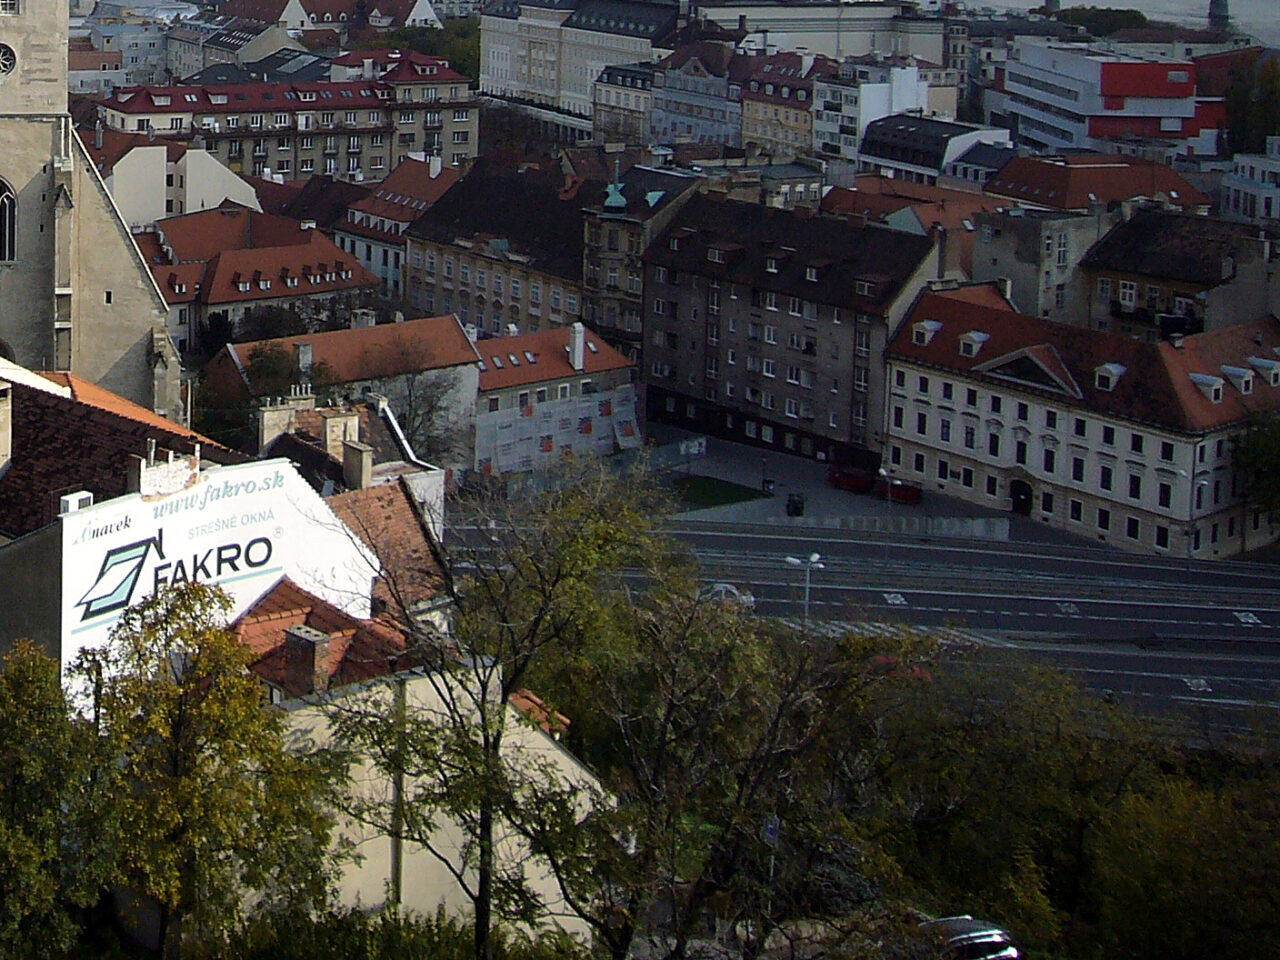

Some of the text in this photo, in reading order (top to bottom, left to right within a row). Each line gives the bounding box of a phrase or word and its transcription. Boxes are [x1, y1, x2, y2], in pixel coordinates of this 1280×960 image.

[152, 470, 285, 519] www.fakro.sk
[240, 506, 276, 526] OKNÁ
[153, 536, 273, 598] FAKRO
